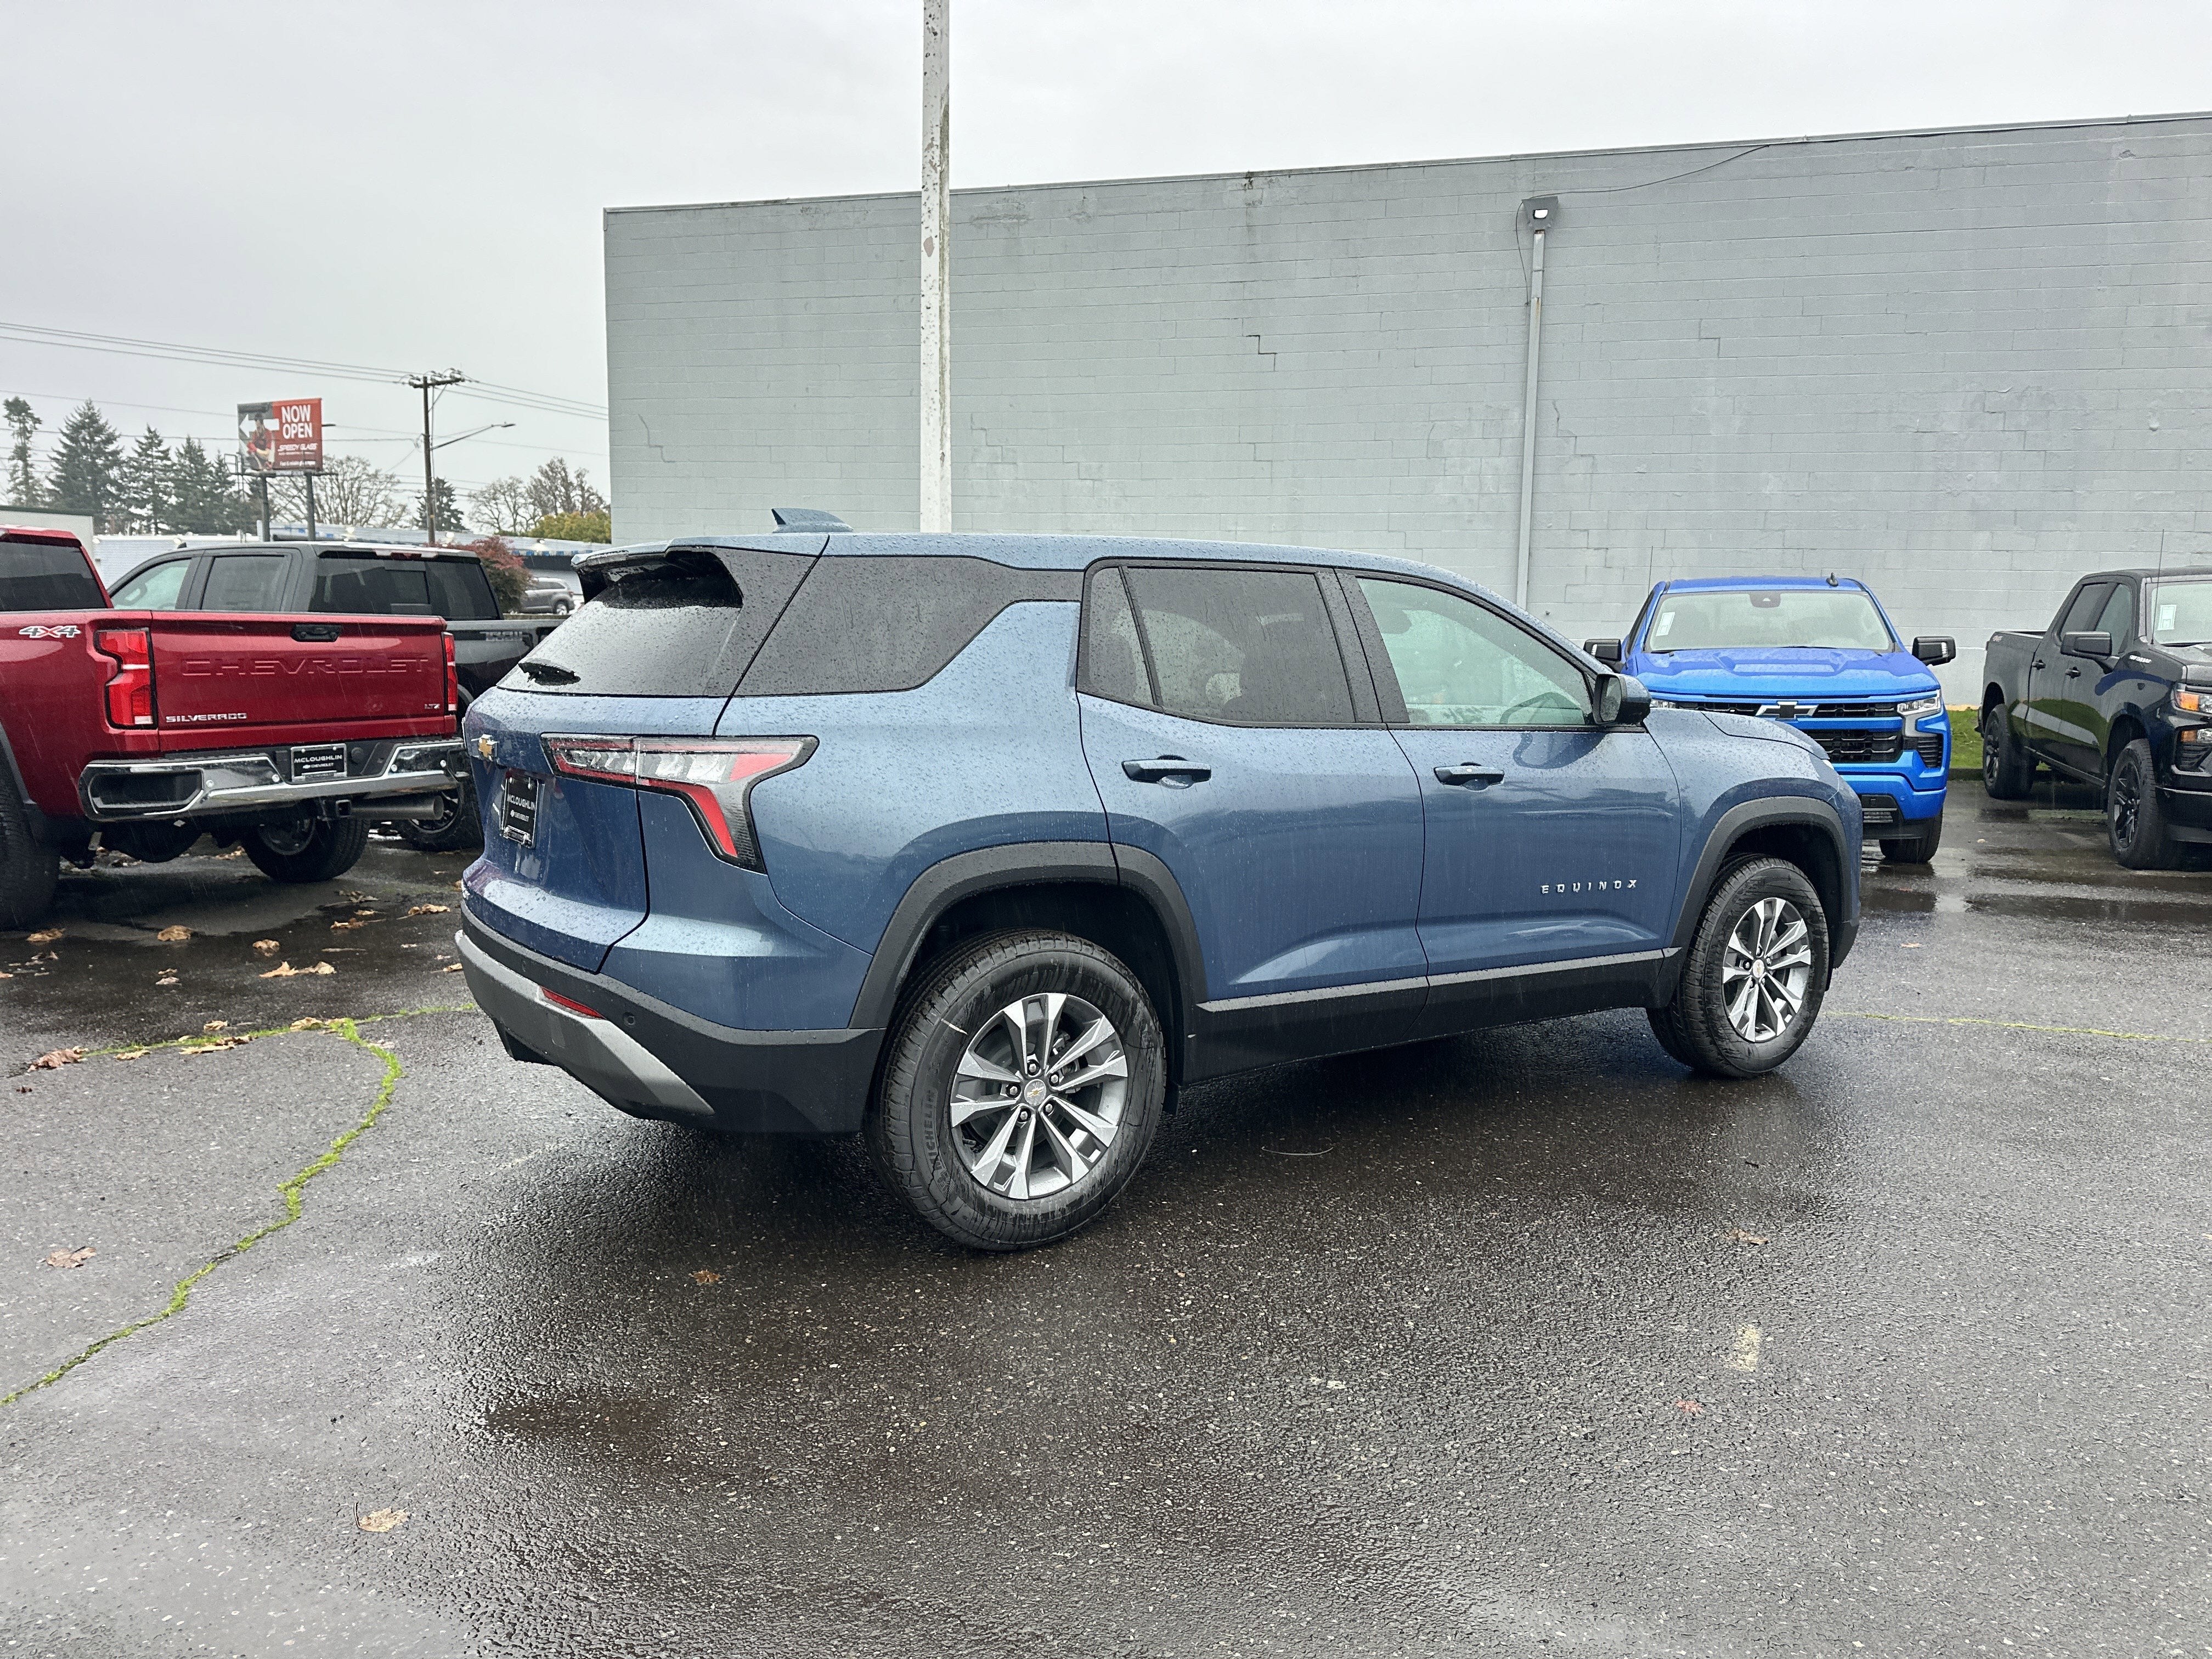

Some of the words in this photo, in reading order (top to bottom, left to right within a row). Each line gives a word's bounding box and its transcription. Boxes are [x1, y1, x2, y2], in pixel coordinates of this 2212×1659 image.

[281, 404, 311, 423] NOW
[283, 422, 313, 439] OPEN
[182, 658, 428, 676] CHEVROLET
[166, 713, 247, 723] SILVERADO
[294, 754, 342, 763] MCLOUGHLIN
[507, 794, 535, 811] MCLOUGHLIN
[1541, 879, 1637, 894] EQUINOX
[923, 1089, 943, 1170] MICHELIN
